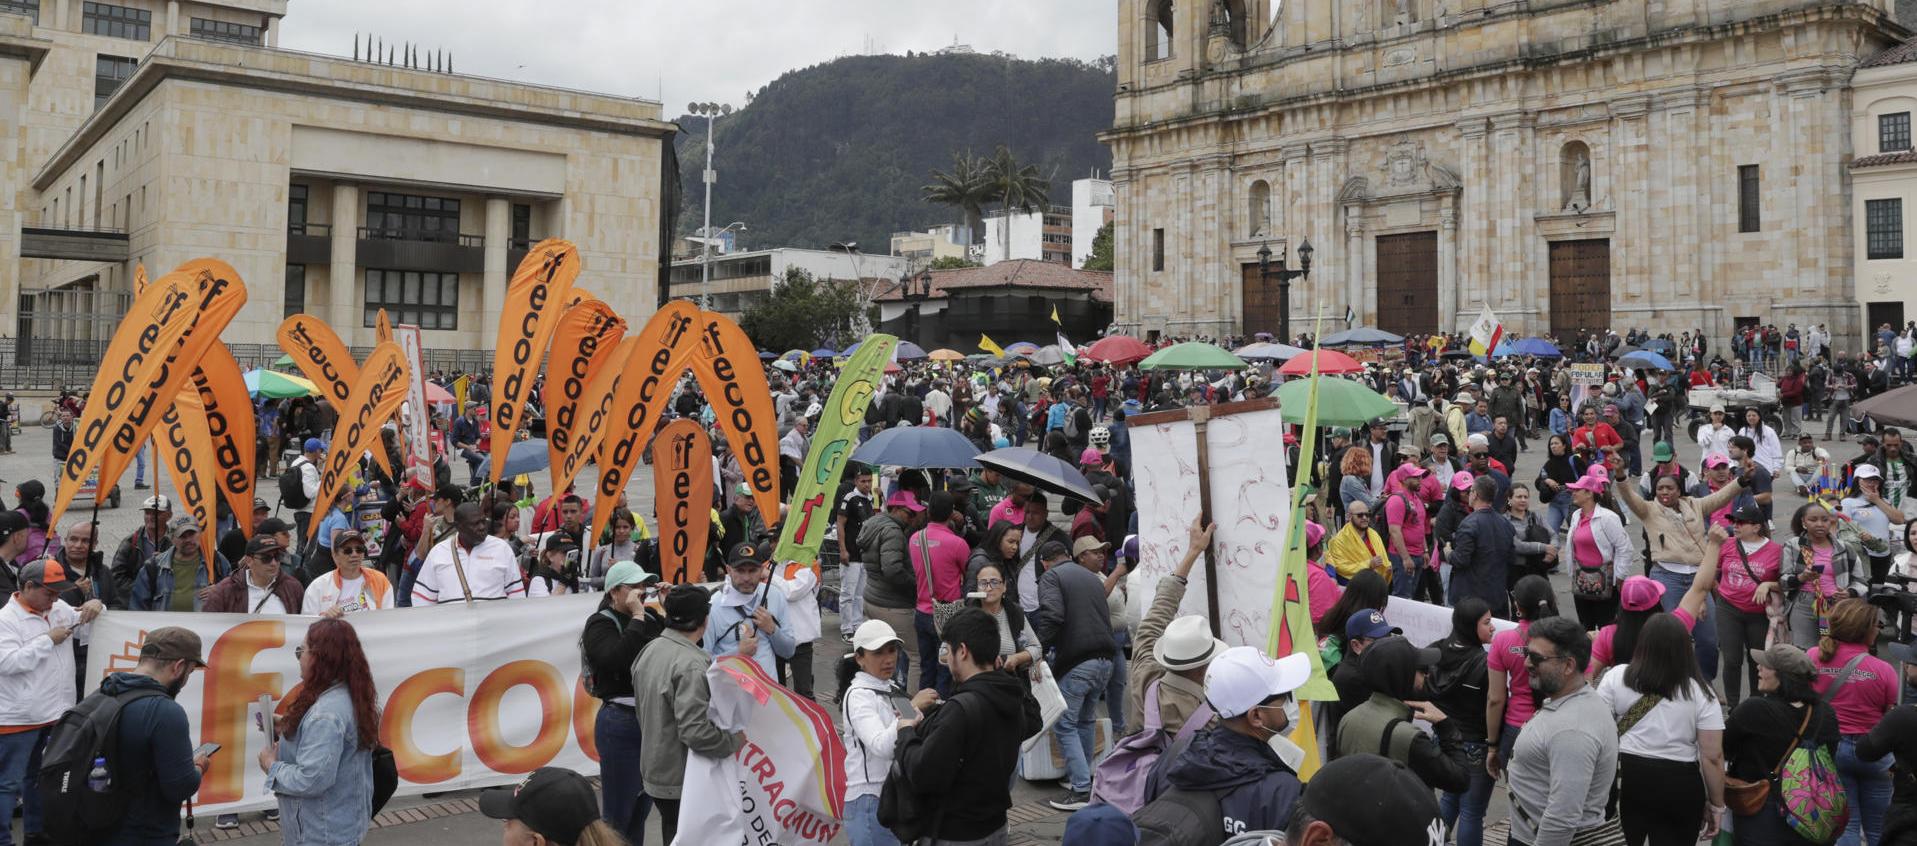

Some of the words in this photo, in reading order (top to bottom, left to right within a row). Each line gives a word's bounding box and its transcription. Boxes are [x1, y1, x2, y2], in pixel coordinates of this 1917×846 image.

[66, 291, 188, 482] fecode
[295, 321, 350, 401] feco
[497, 252, 566, 430] fecode
[552, 317, 618, 453] fecode
[601, 317, 691, 497] fecode
[704, 321, 773, 493] fecode
[323, 366, 402, 498] fecode
[673, 432, 695, 584] fecod
[794, 379, 875, 545] CGT
